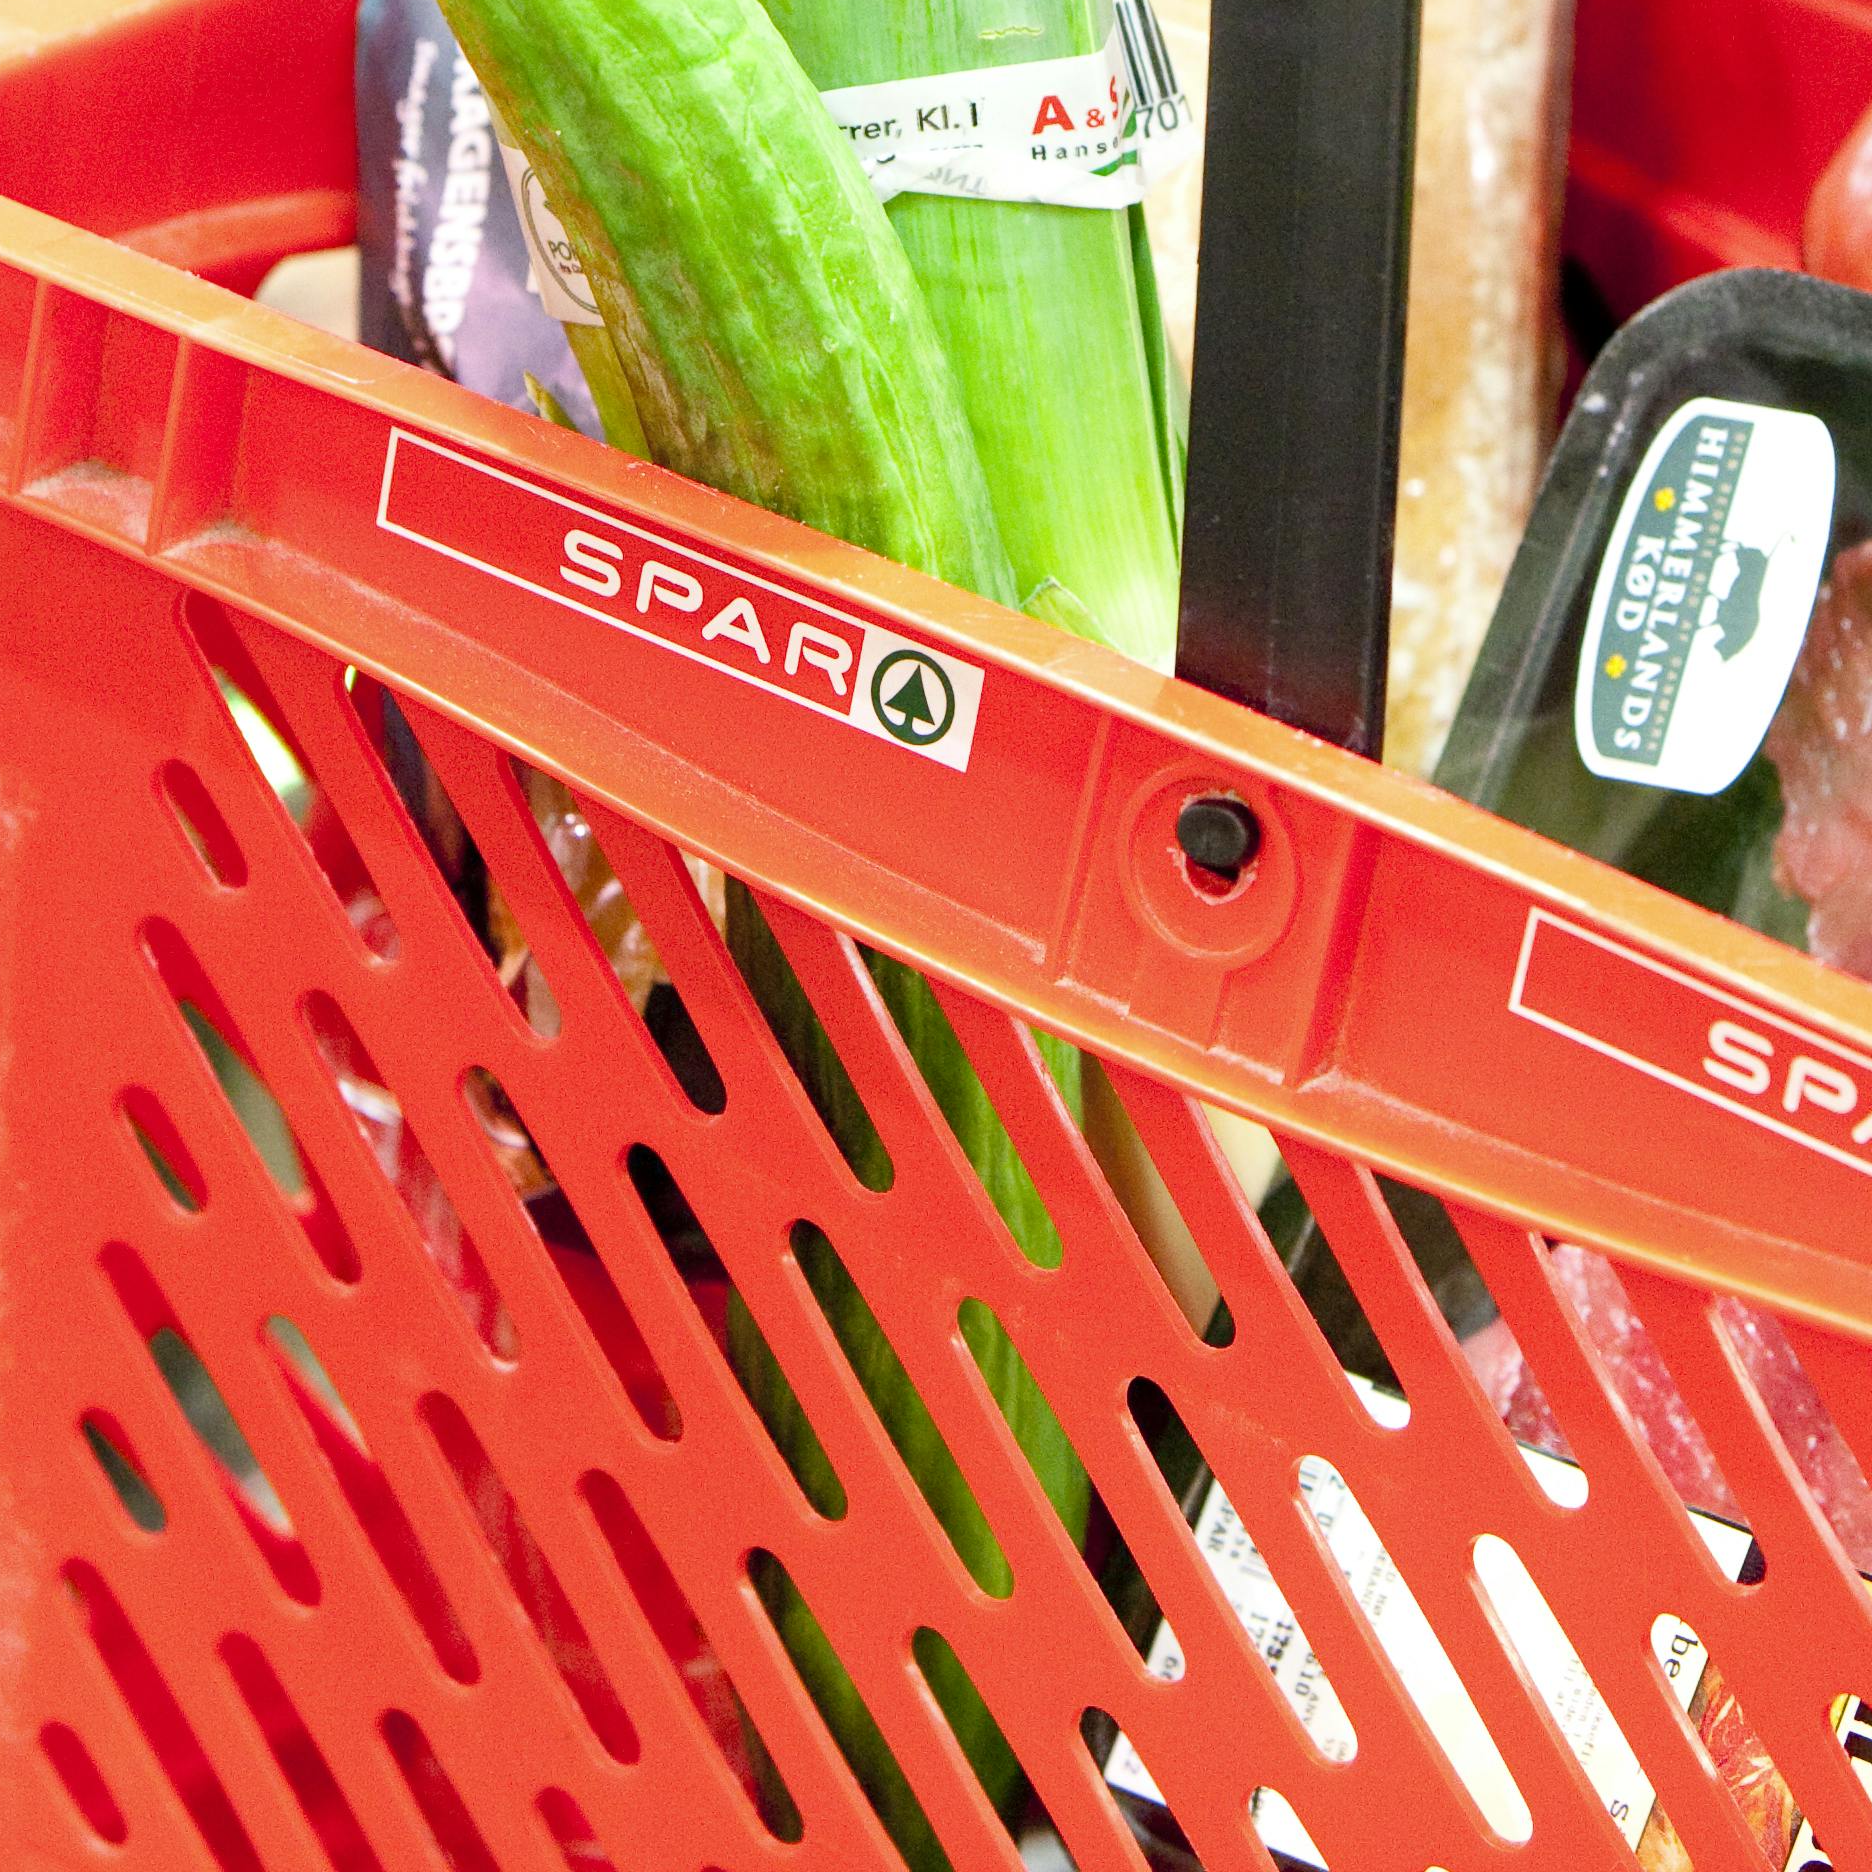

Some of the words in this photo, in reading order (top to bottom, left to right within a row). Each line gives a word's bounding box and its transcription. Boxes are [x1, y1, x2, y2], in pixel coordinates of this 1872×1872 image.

[917, 104, 961, 133] Kl.
[1032, 95, 1075, 135] A
[1085, 107, 1105, 128] &
[559, 529, 857, 696] SPAR
[1613, 425, 1728, 752] HIMMERLANDS
[1615, 534, 1667, 632] KØD
